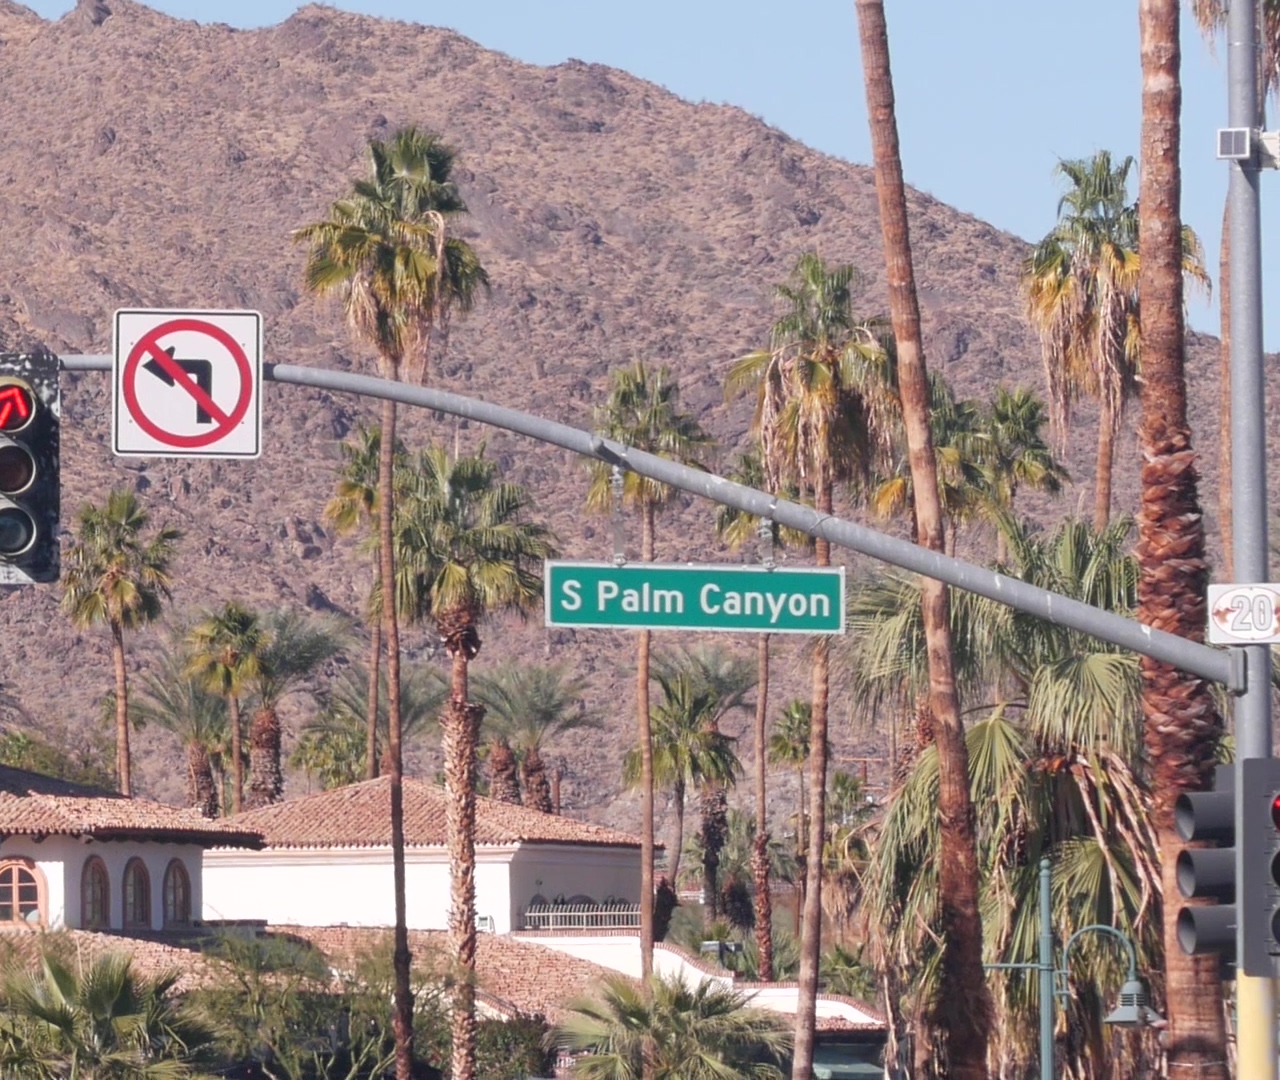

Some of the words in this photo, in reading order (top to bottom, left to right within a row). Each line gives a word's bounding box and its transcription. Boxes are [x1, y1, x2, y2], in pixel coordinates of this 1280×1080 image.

[560, 580, 582, 611] S
[597, 580, 684, 614] Palm
[700, 583, 830, 623] Canyon
